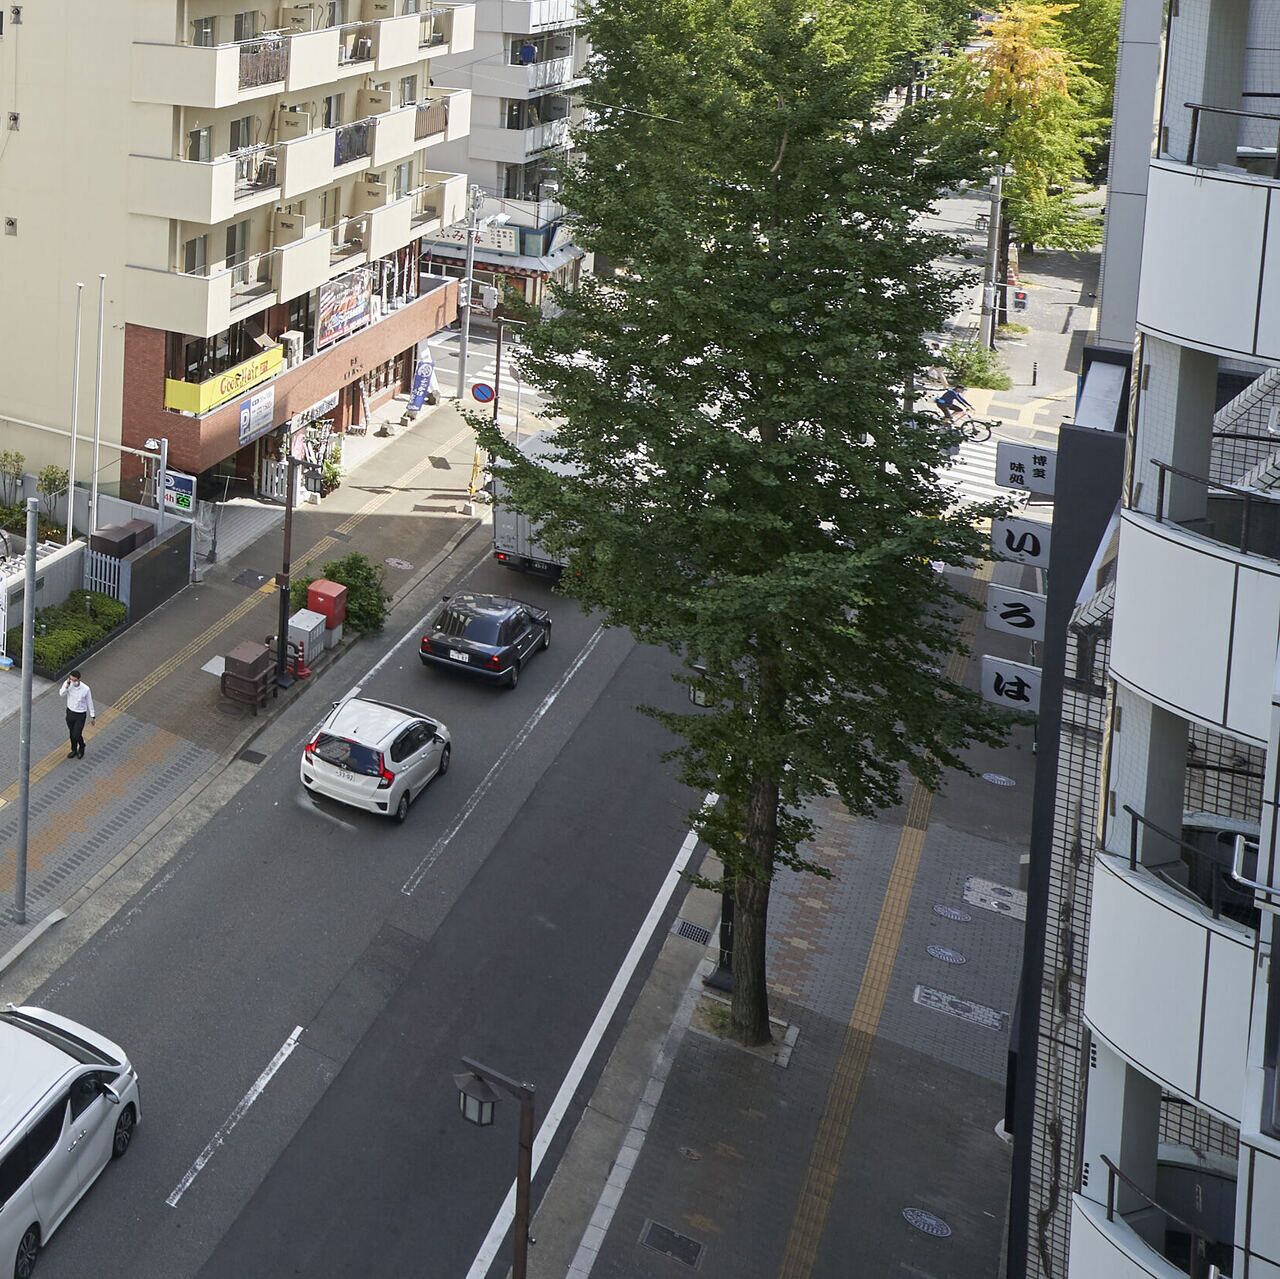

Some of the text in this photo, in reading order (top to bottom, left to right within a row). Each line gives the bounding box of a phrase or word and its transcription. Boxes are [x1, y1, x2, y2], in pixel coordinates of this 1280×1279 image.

[1009, 454, 1047, 486] 博多 味処
[1005, 528, 1041, 558] い
[999, 601, 1036, 630] ろ
[993, 671, 1032, 703] は
